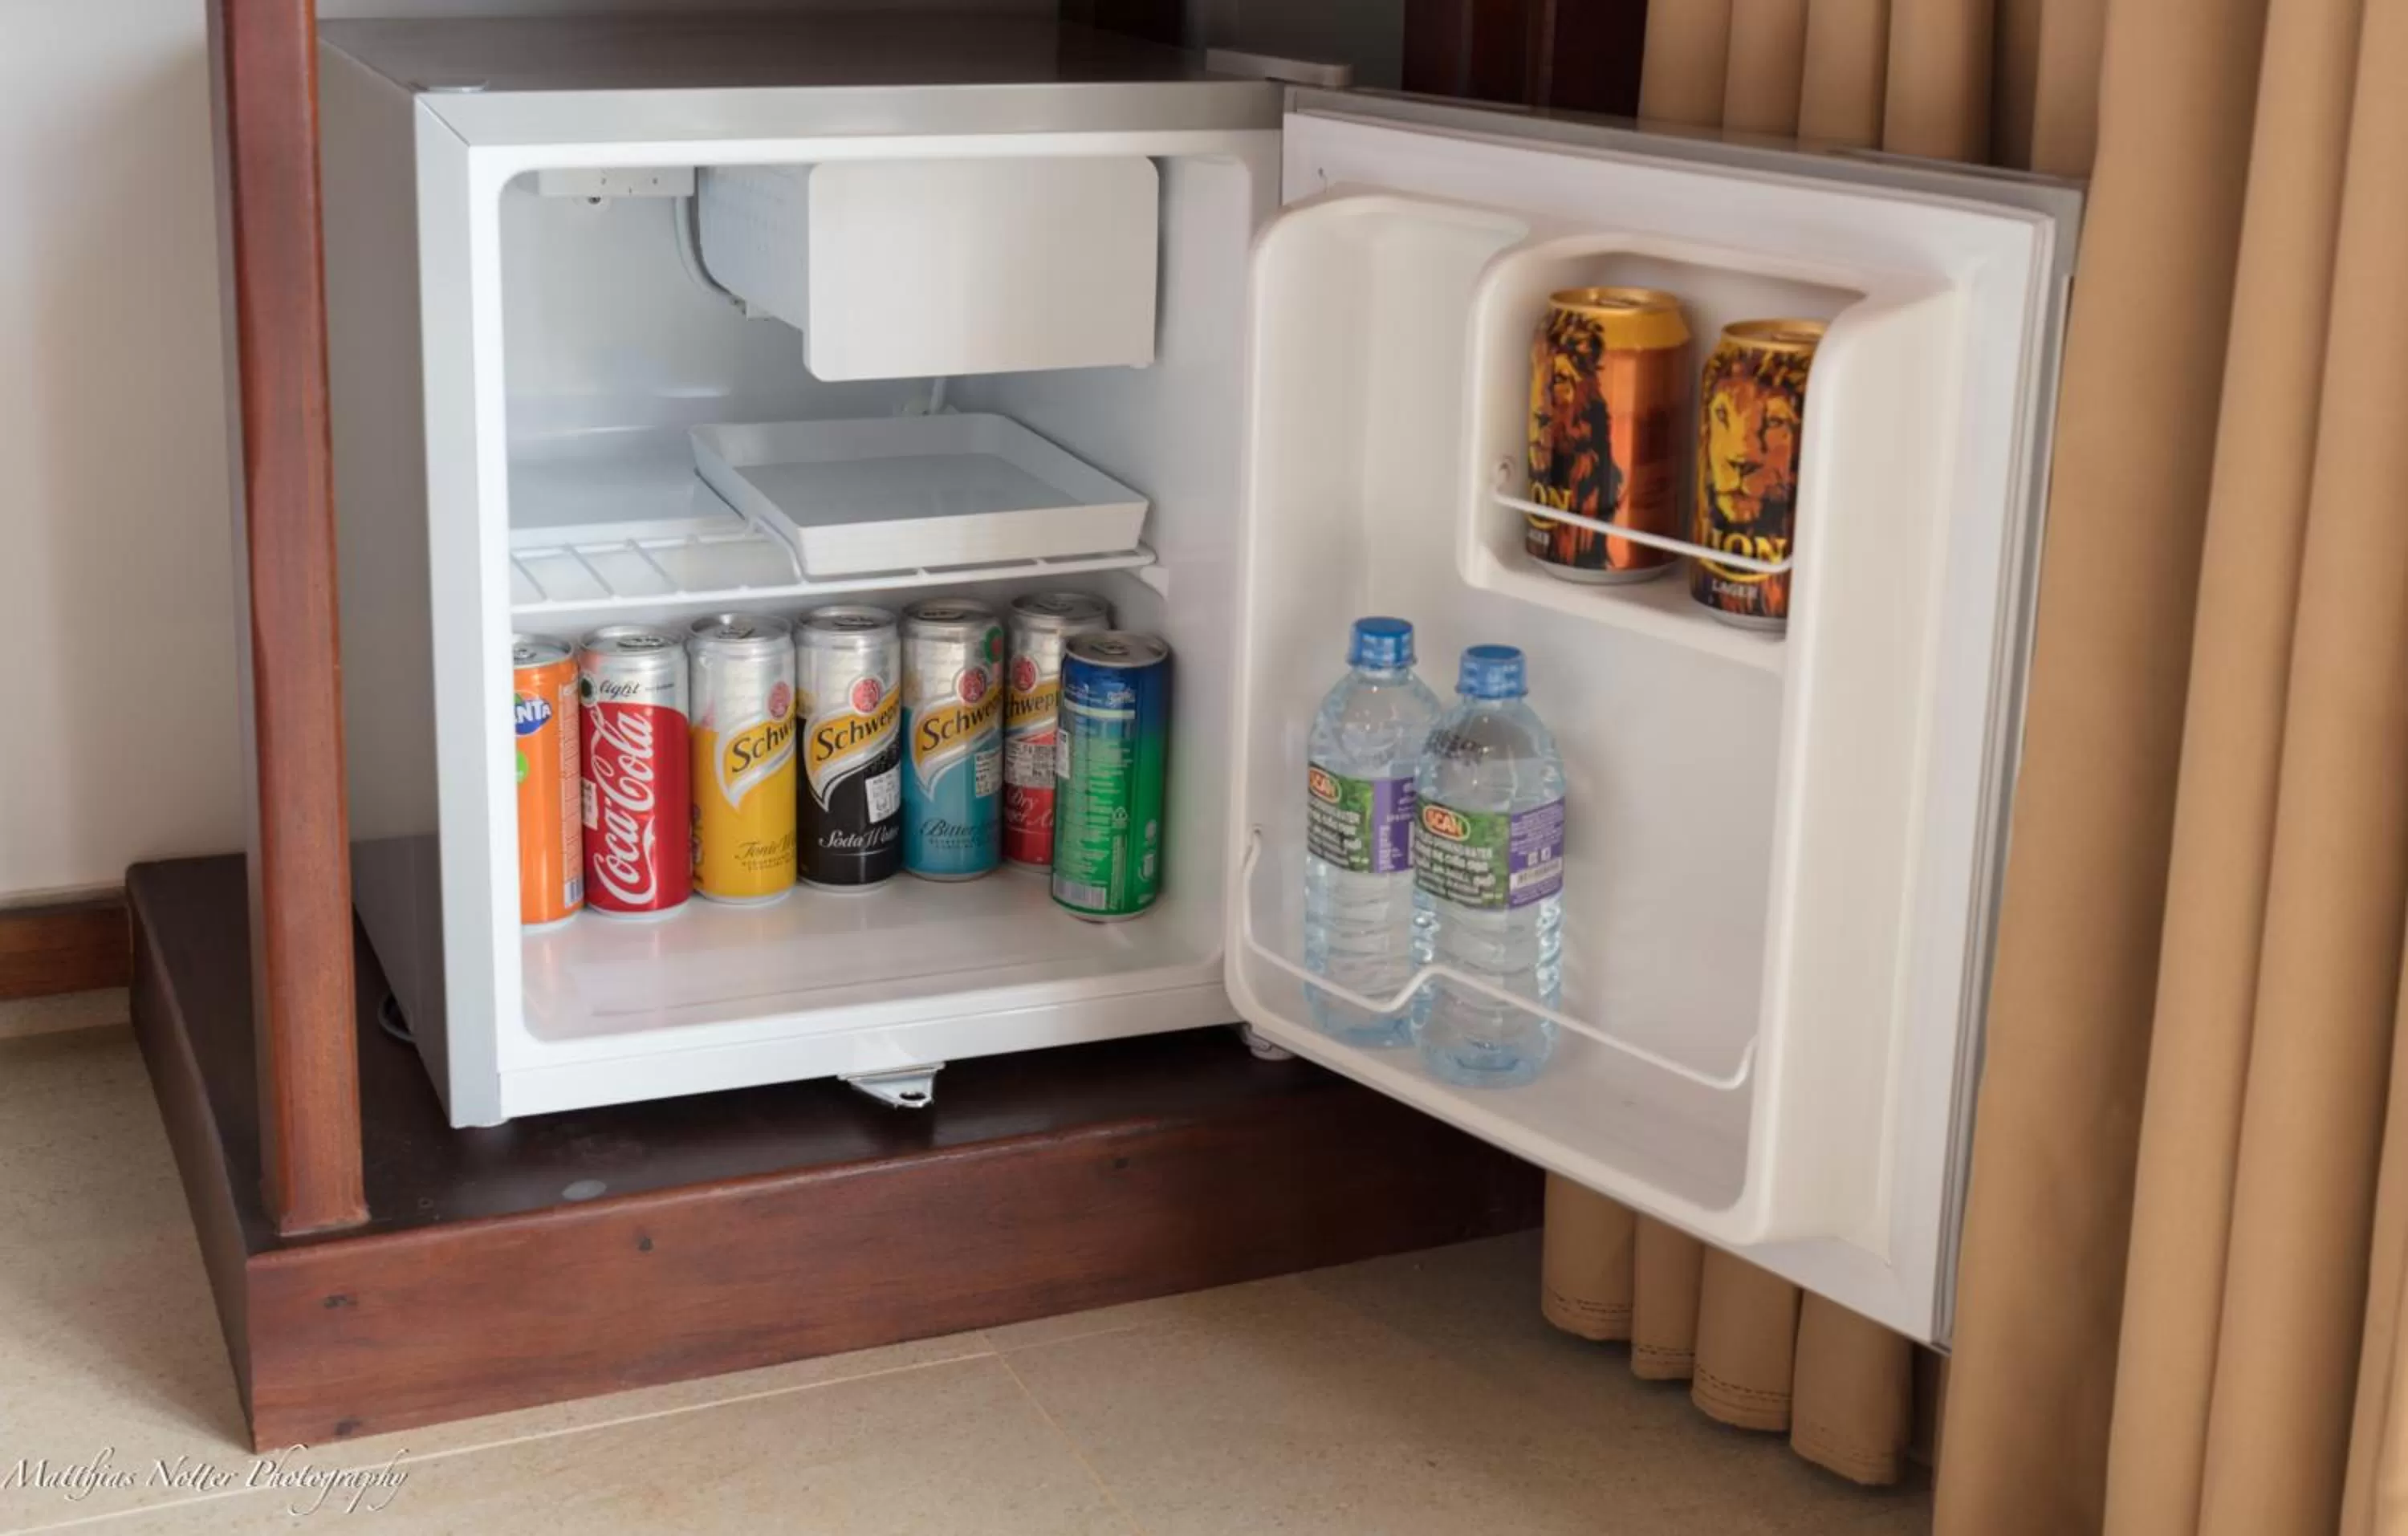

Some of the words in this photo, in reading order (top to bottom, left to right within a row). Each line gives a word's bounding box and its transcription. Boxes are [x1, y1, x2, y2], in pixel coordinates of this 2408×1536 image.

[1528, 481, 1572, 511] ON
[514, 699, 551, 724] NTA
[1426, 809, 1465, 839] SCAN
